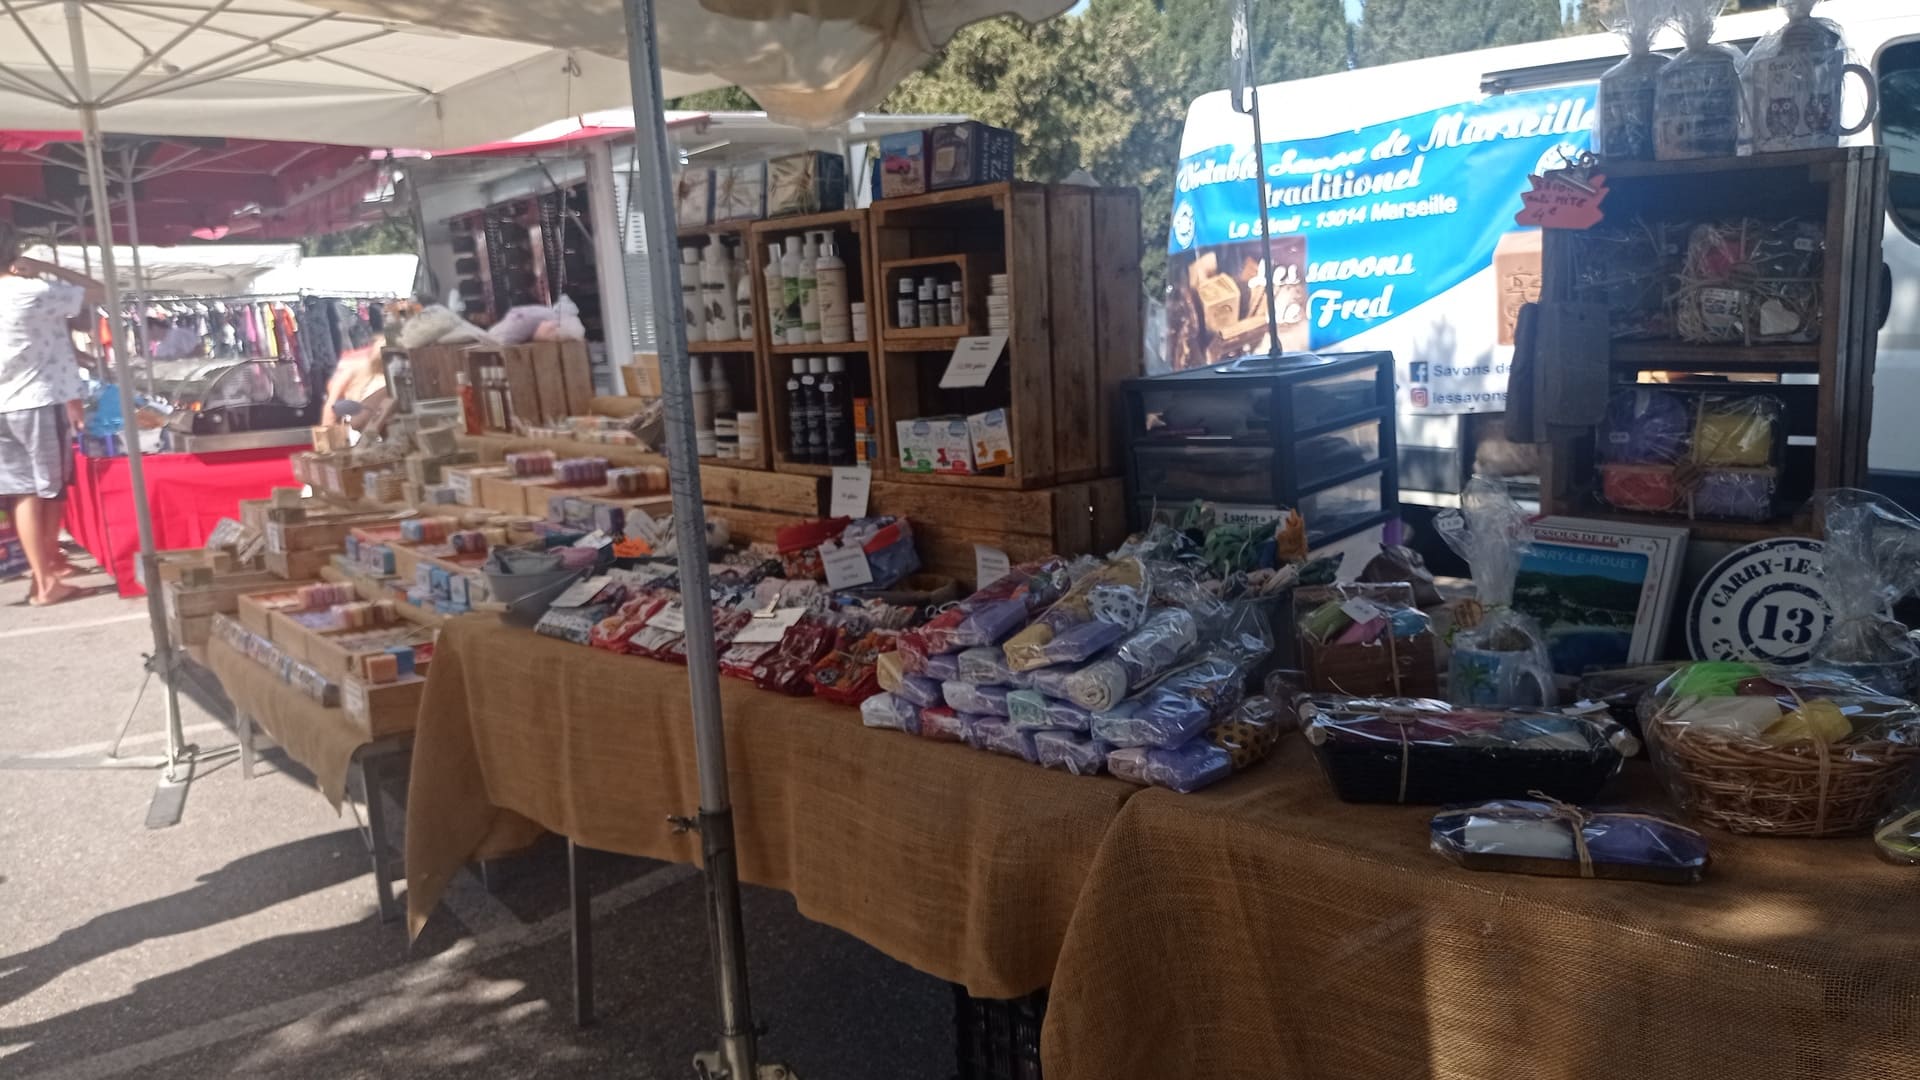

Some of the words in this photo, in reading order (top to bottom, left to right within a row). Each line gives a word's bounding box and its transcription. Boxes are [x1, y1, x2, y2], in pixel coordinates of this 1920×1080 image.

[1370, 128, 1412, 160] de
[990, 159, 1002, 179] 72
[1264, 154, 1424, 208] traditionel
[1229, 220, 1249, 239] Le
[1370, 193, 1458, 222] Marseille
[1304, 252, 1417, 283] savons
[1306, 284, 1395, 328] Fred
[1432, 364, 1491, 377] Savons
[1531, 528, 1579, 542] ESSOUS
[1581, 532, 1598, 542] DE
[1602, 534, 1634, 546] PLAT
[1757, 604, 1815, 645] 13
